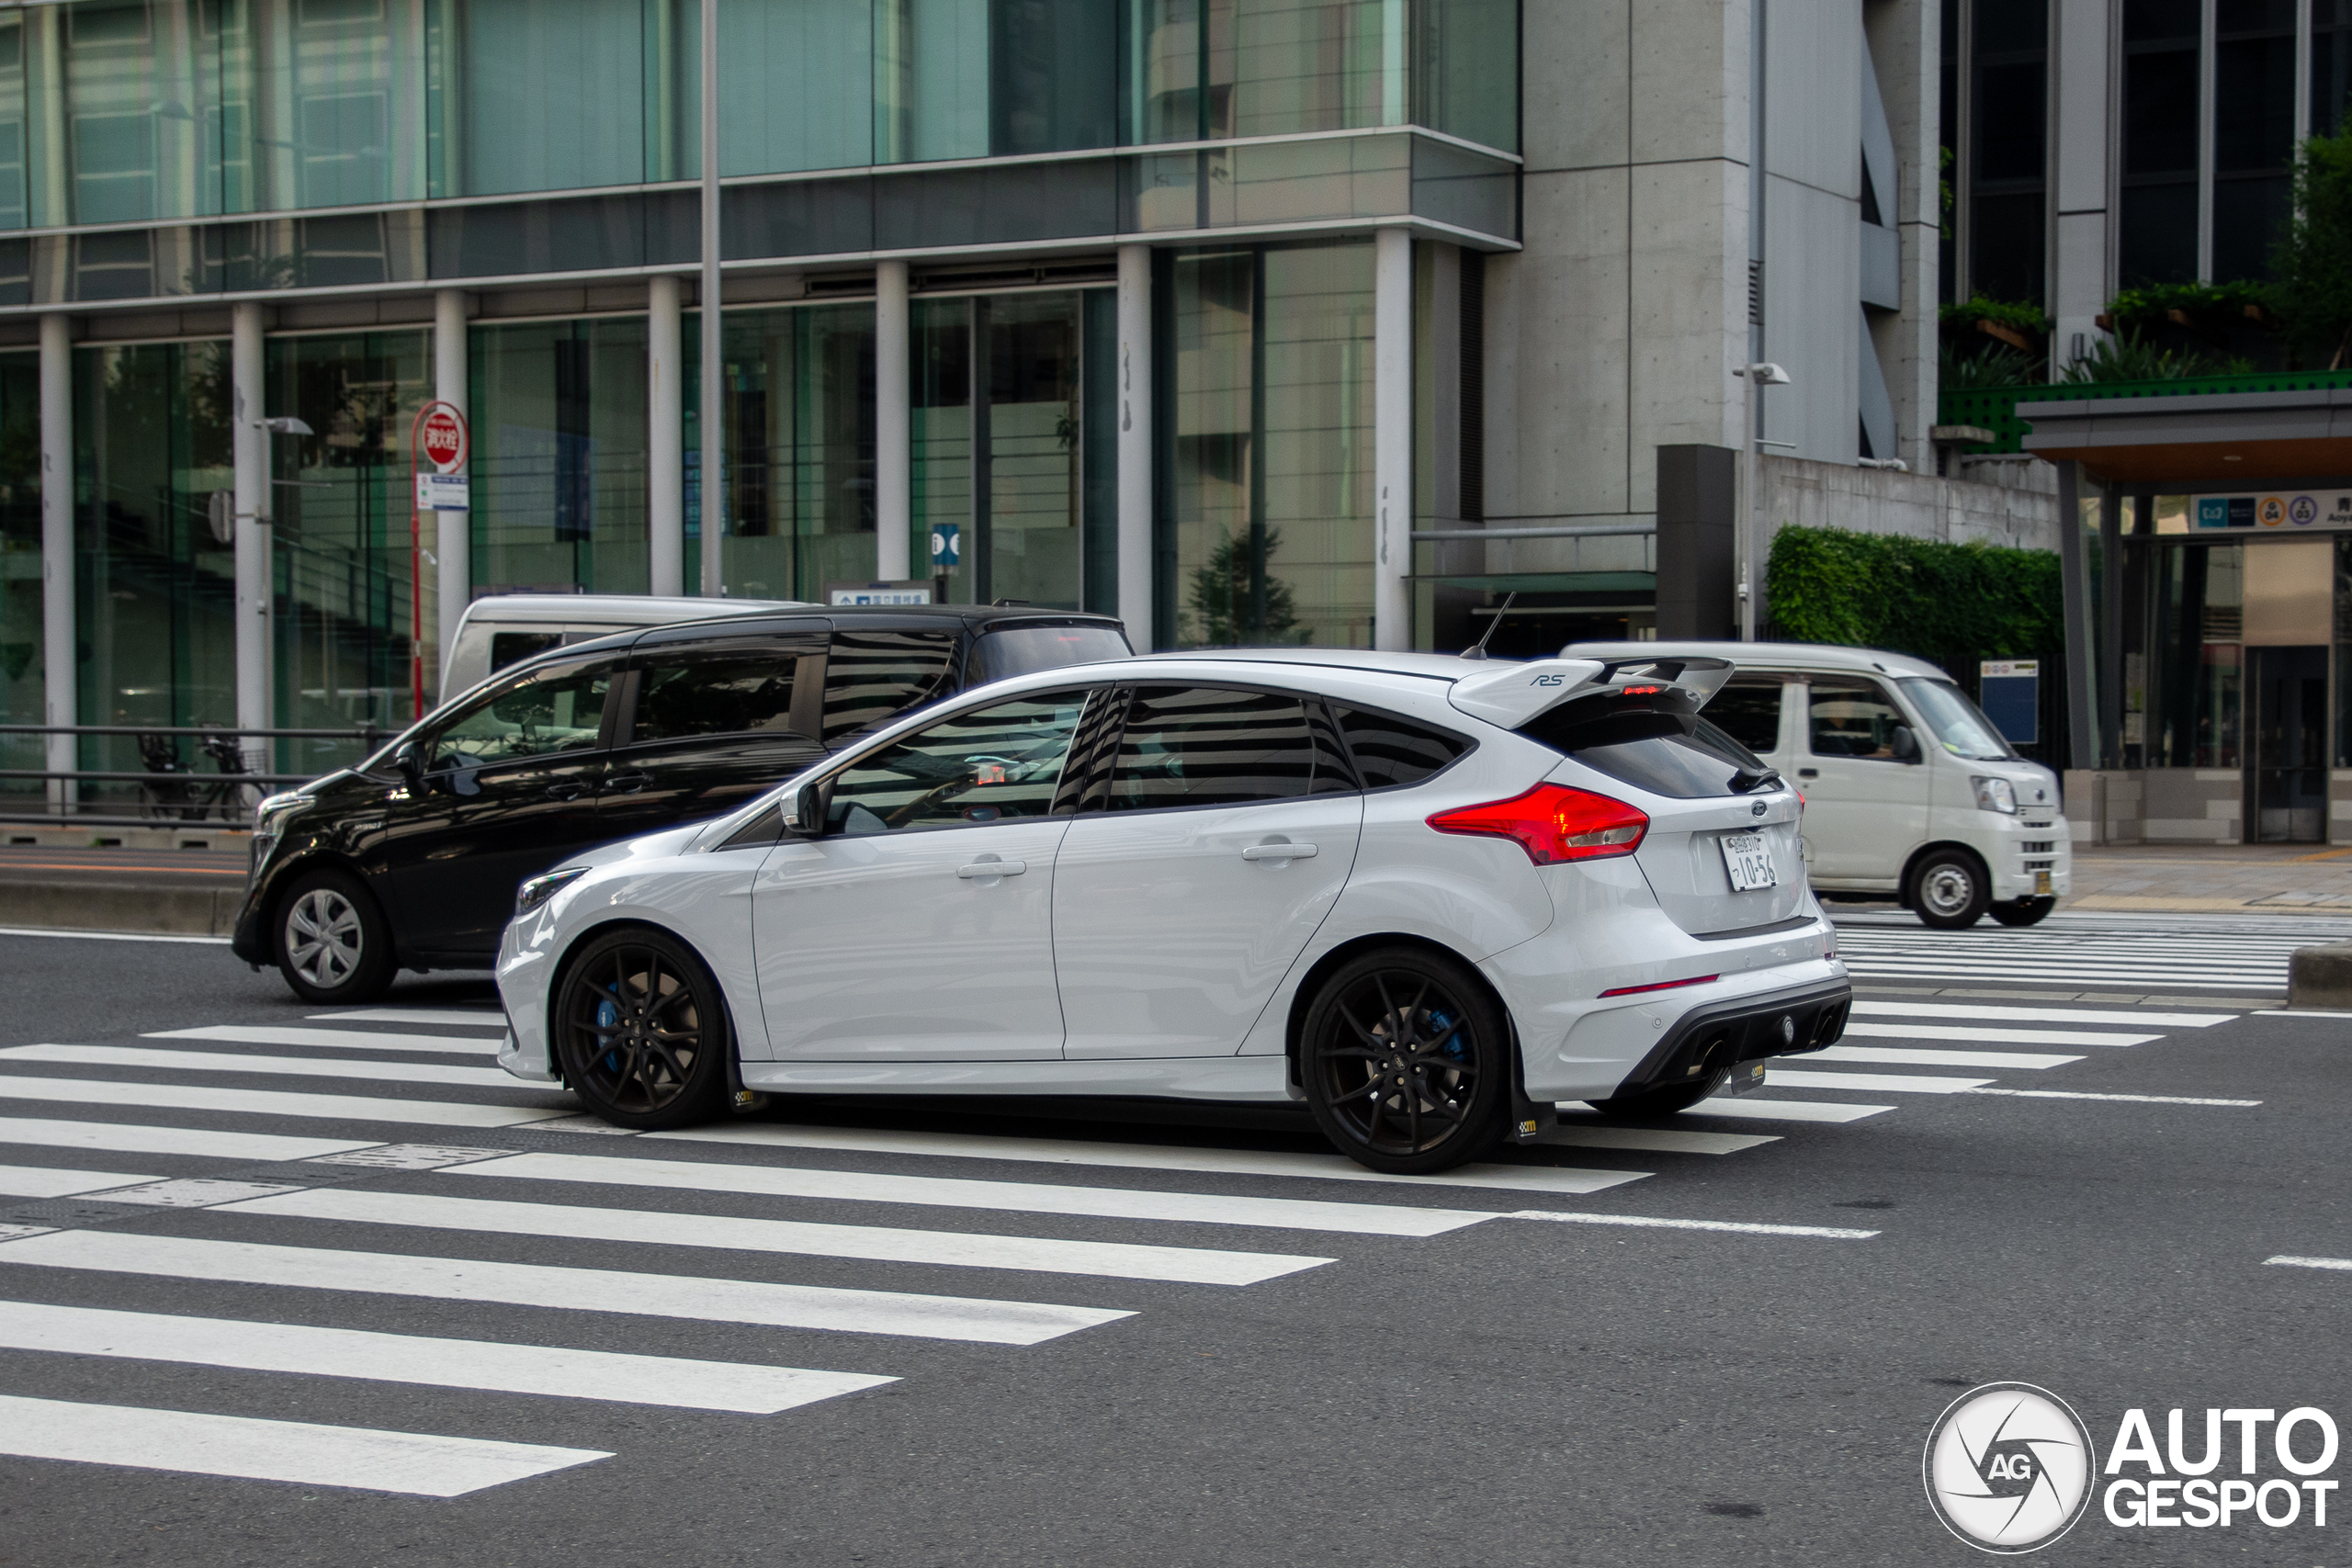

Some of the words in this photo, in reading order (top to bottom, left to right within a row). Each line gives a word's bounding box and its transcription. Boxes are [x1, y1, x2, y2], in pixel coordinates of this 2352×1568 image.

[427, 428, 458, 450] 消火栓
[2266, 511, 2278, 520] 04
[2297, 510, 2310, 519] 03
[1530, 675, 1566, 686] RS
[1739, 854, 1775, 885] 10-56
